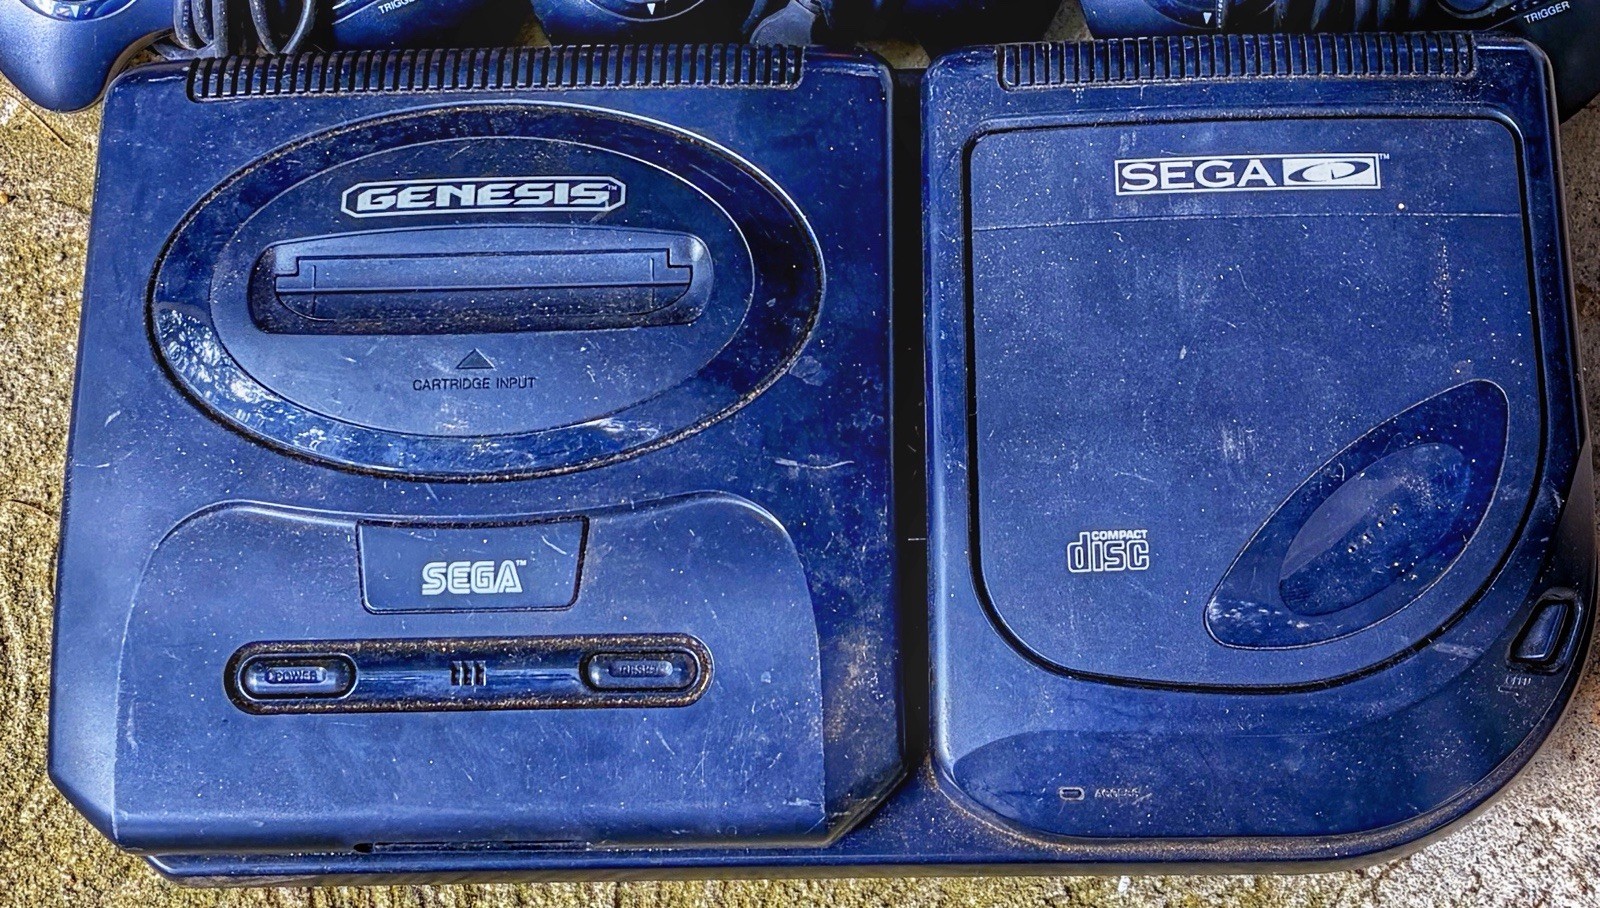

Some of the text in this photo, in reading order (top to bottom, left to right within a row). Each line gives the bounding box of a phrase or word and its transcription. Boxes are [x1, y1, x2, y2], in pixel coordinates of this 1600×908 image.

[1524, 1, 1570, 24] TRIGGER
[1121, 159, 1277, 191] SEGA
[357, 183, 612, 211] GENESIS
[412, 376, 536, 391] CARTRIDGE INPUT
[1091, 529, 1148, 540] COMPACT
[421, 560, 523, 595] SEGA
[275, 670, 318, 682] POWER
